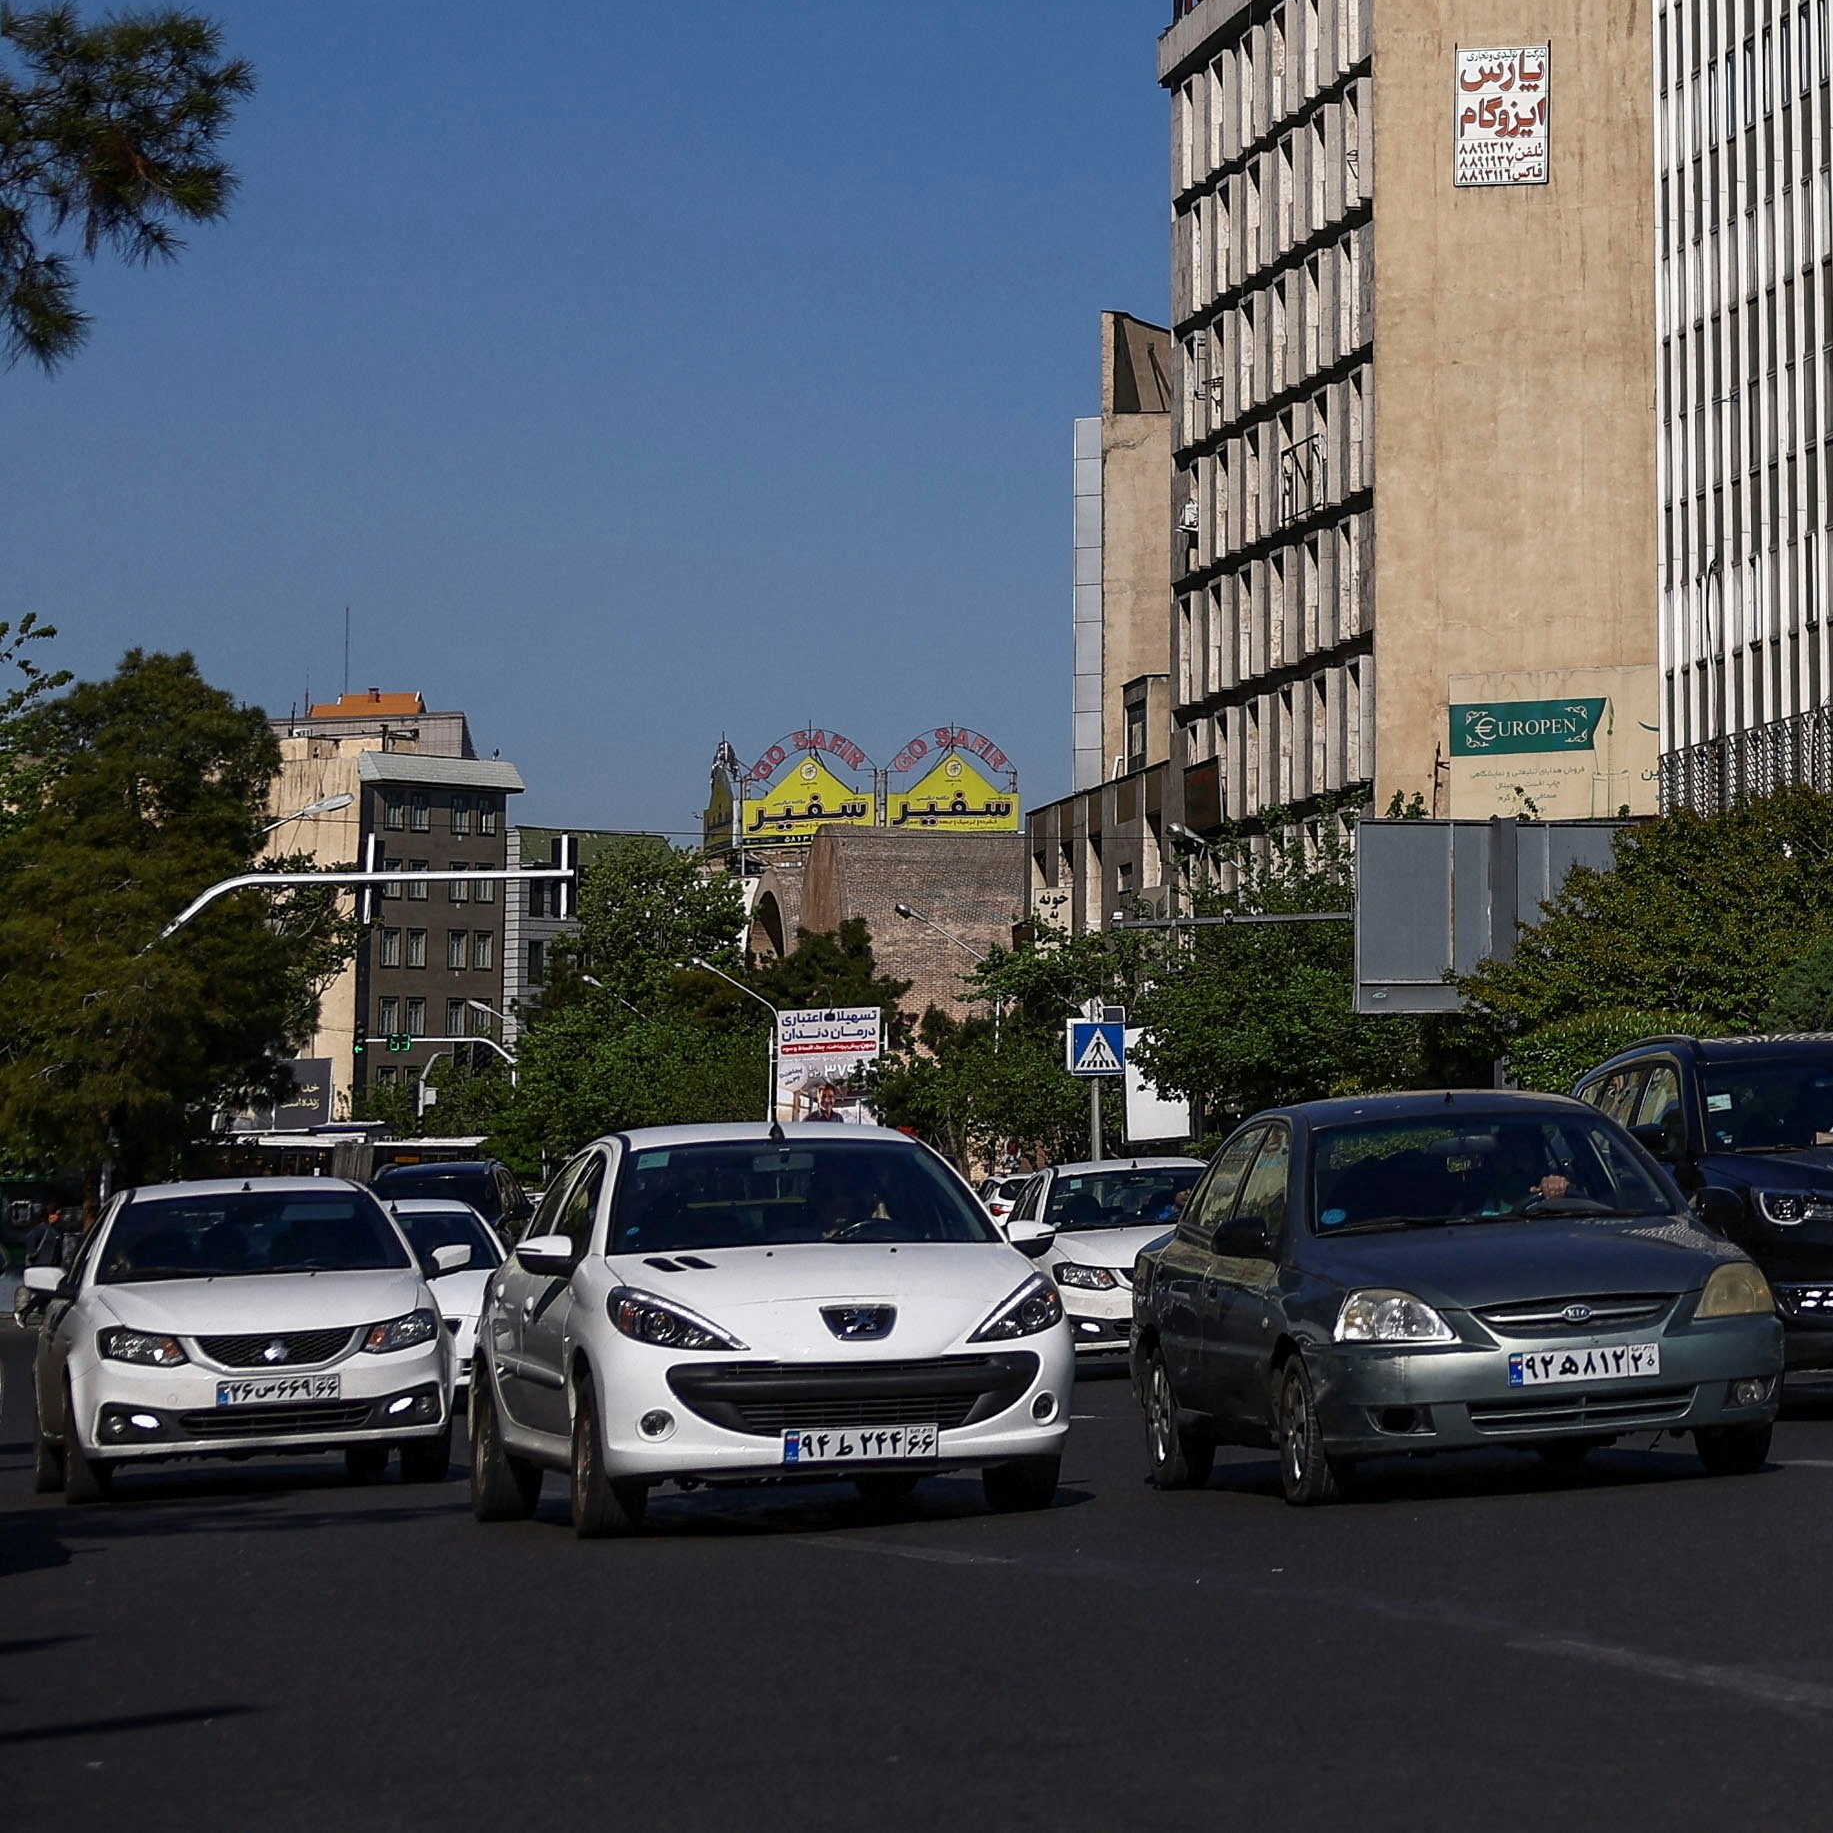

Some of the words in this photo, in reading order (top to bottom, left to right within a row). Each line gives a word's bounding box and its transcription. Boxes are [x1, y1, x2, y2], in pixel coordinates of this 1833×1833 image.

[1460, 49, 1545, 92] پارس
[1460, 96, 1546, 138] ایزوگام
[1515, 142, 1543, 161] تلفن
[1513, 163, 1543, 181] فاکس
[752, 745, 786, 780] GO
[792, 729, 865, 771] SAFIR
[895, 739, 928, 772] GO
[934, 727, 1007, 772] SAFIR
[747, 793, 868, 834] سفیر
[890, 790, 1013, 827] سفیر
[1039, 890, 1069, 909] خونه
[1050, 911, 1059, 923] به
[782, 1012, 823, 1027] اعتباری
[825, 1010, 877, 1025] تسهیلا
[390, 1033, 411, 1051] 63
[782, 1028, 829, 1042] دندان
[830, 1027, 876, 1039] درمان
[301, 1085, 320, 1094] خد
[1631, 1353, 1655, 1373] ۲۰
[908, 1434, 935, 1455] ۶۶
